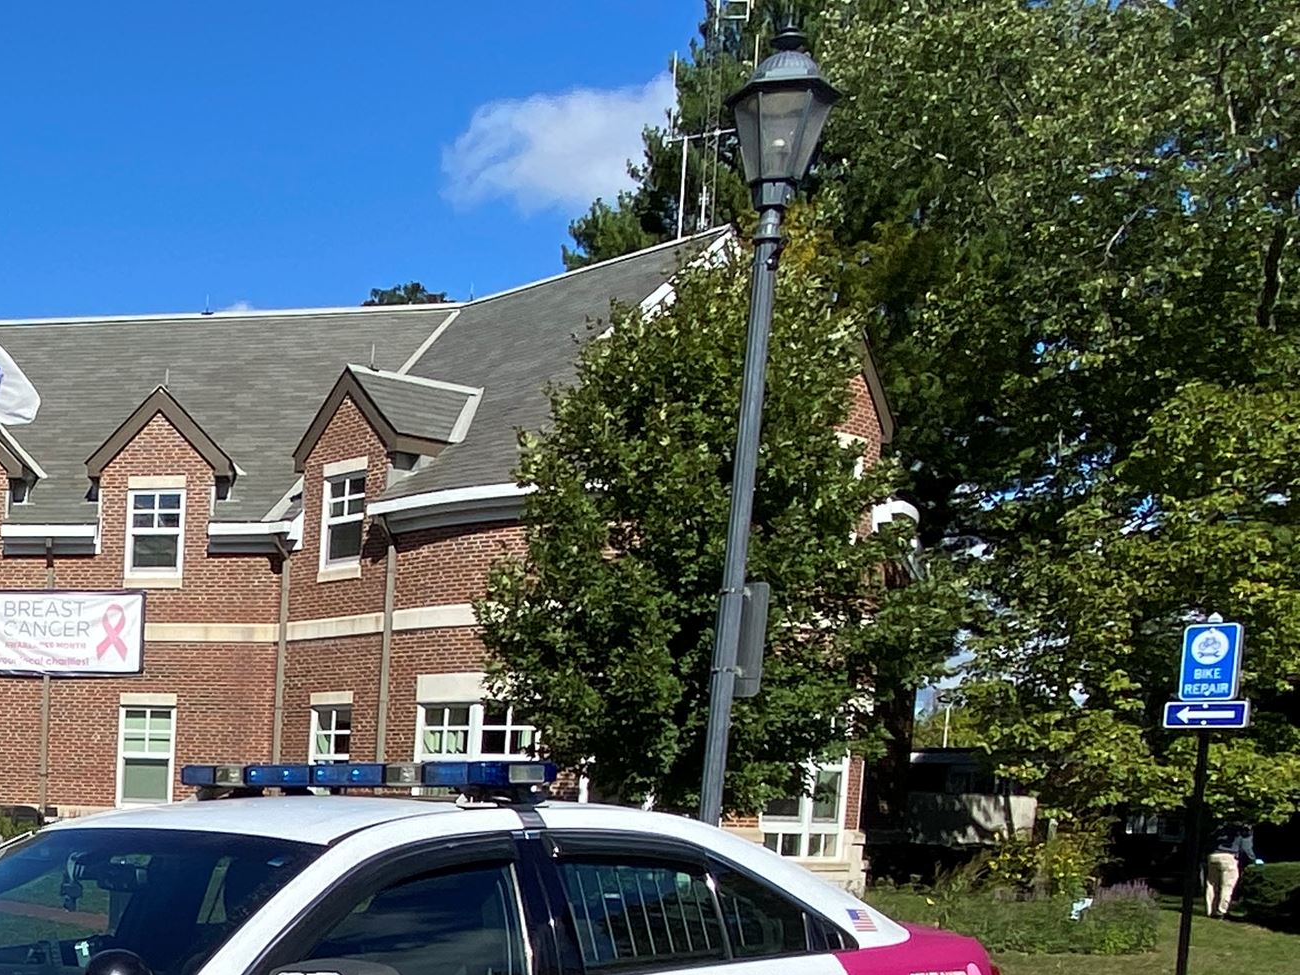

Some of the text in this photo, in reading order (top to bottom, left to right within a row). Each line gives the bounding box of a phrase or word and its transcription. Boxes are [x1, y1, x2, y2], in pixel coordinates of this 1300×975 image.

[3, 600, 86, 618] BREAST
[3, 620, 91, 638] CANCER
[1193, 668, 1222, 680] BIKE
[1183, 682, 1229, 695] REPAIR
